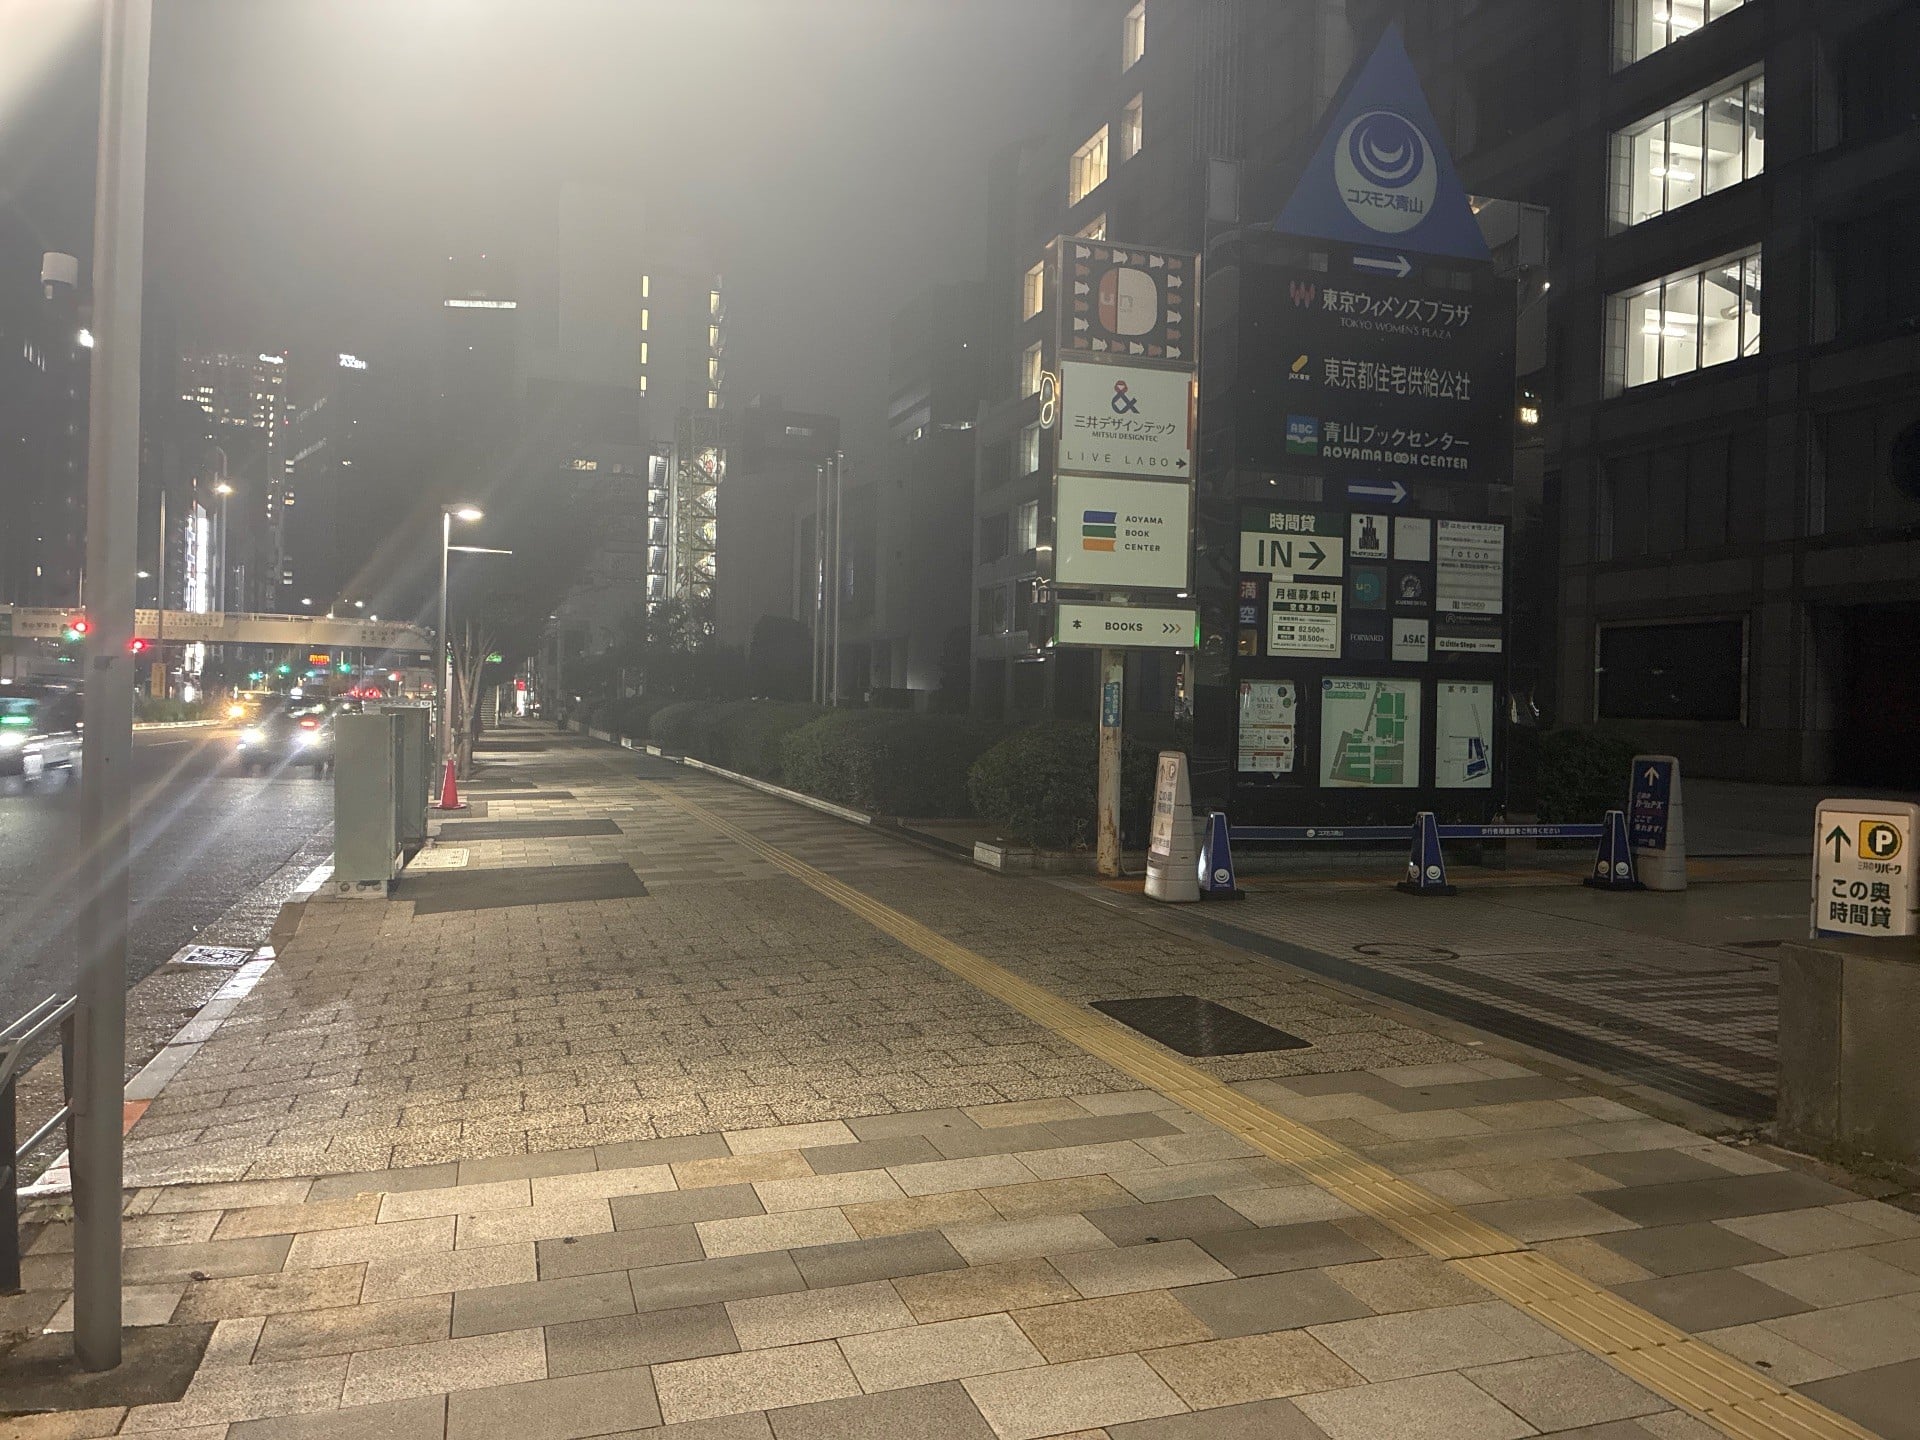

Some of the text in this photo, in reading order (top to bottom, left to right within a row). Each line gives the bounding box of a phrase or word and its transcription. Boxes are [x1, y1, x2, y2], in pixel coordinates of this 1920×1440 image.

[1347, 188, 1423, 214] コスモス青山
[1322, 287, 1472, 327] 東京ウィメンズプラザ
[1341, 317, 1452, 340] TOKYO WOMEN'S PLAZA
[1323, 357, 1471, 401] 東京都住宅供給公社
[1074, 415, 1176, 435] 三井デザインテック
[1290, 423, 1313, 435] ABC
[1092, 431, 1158, 442] MITSUI DESIGNTEC
[1323, 421, 1471, 452] 青山ブックセンター
[1067, 451, 1111, 463] LIVE
[1322, 445, 1468, 471] AOYAMA BOOK CENTER
[1125, 515, 1163, 526] AOYAMA
[1269, 513, 1316, 533] 時間貸
[1125, 530, 1150, 538] BOOK
[1124, 544, 1161, 553] CENTER
[1257, 538, 1293, 569] IN
[1451, 547, 1490, 560] foton
[1105, 622, 1143, 633] BOOKS
[1402, 633, 1426, 645] ASAC
[1334, 681, 1370, 691] コスモス青山
[1875, 829, 1893, 853] P
[1857, 862, 1902, 875] 三井のリパーク
[1831, 878, 1891, 905] この奥
[1829, 901, 1891, 929] 時間貸
